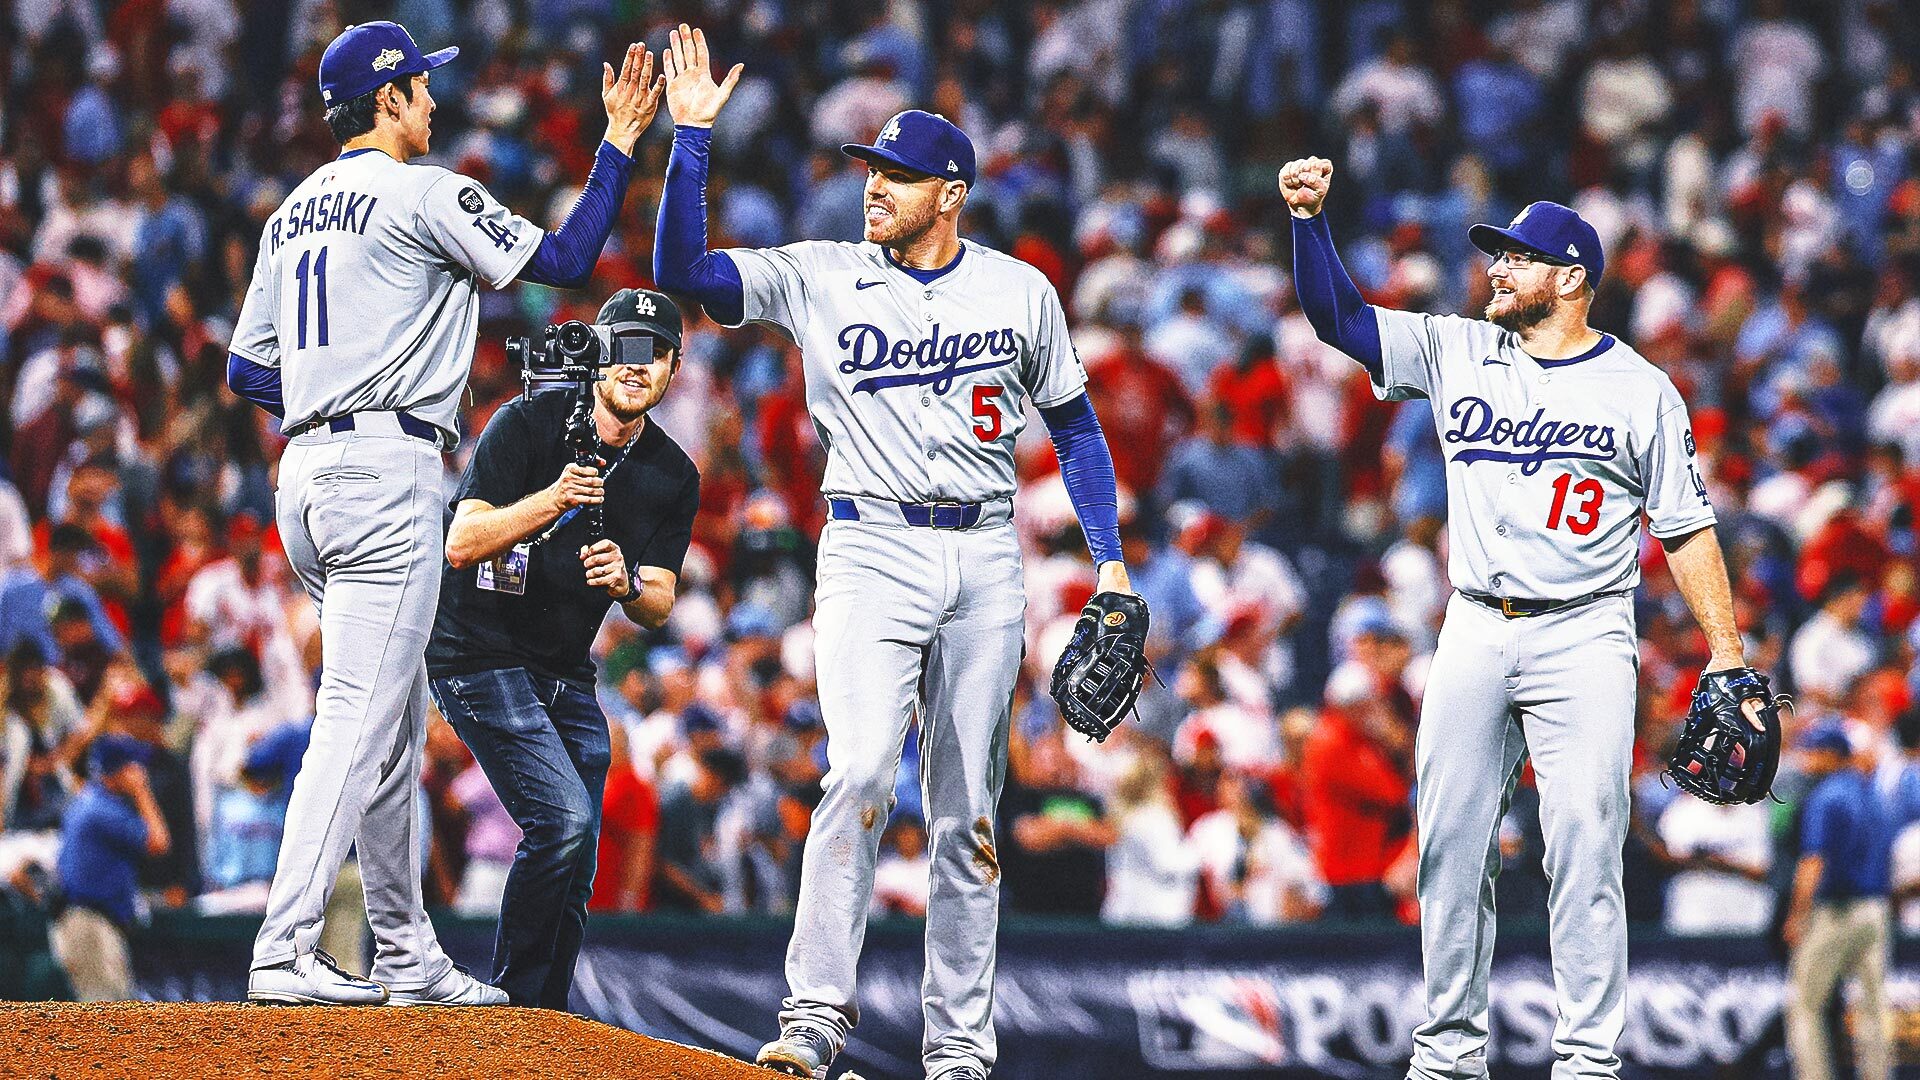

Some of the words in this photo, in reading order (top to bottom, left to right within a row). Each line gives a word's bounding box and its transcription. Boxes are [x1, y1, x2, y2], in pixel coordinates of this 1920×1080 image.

[472, 217, 518, 253] LA
[296, 246, 329, 350] 11
[635, 293, 656, 316] LA
[838, 323, 1018, 396] Dodgers
[972, 385, 1004, 442] 5
[1445, 396, 1617, 476] Dodgers
[1546, 473, 1604, 535] 13
